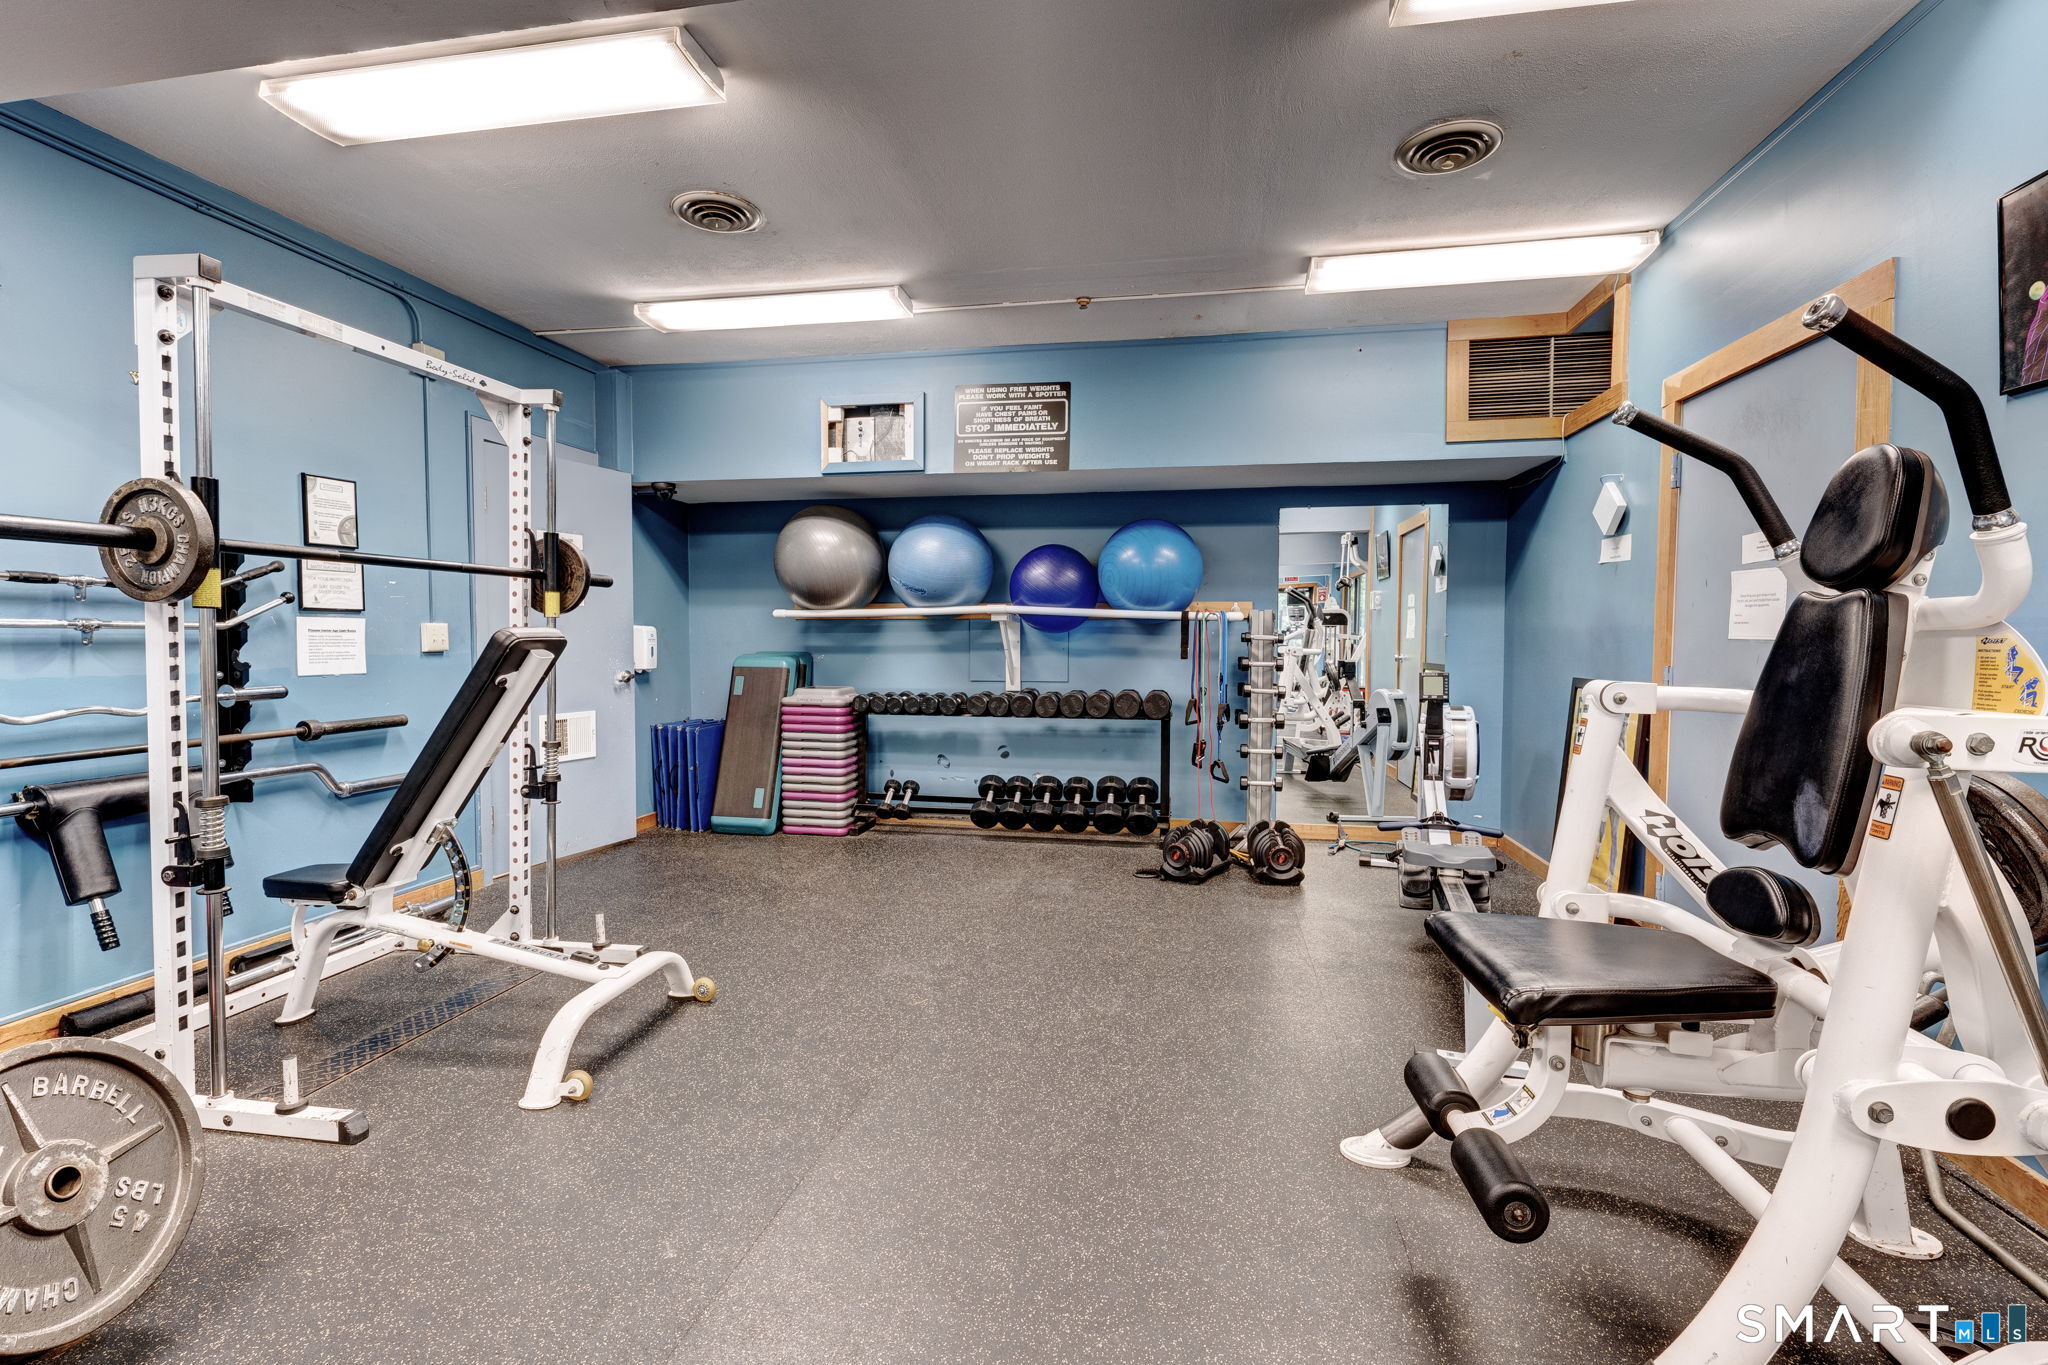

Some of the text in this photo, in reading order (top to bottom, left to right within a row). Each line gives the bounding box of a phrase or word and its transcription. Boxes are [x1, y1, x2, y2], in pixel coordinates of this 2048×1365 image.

[425, 359, 476, 383] Body-Solid
[1030, 384, 1060, 392] WEIGHTS
[1035, 390, 1066, 398] SPOTTER
[965, 422, 1059, 433] STOP IMMEDIATELY
[1639, 809, 1722, 885] HOIS
[31, 1072, 145, 1125] BARBELL
[113, 1176, 166, 1206] LBS
[108, 1205, 152, 1233] 45
